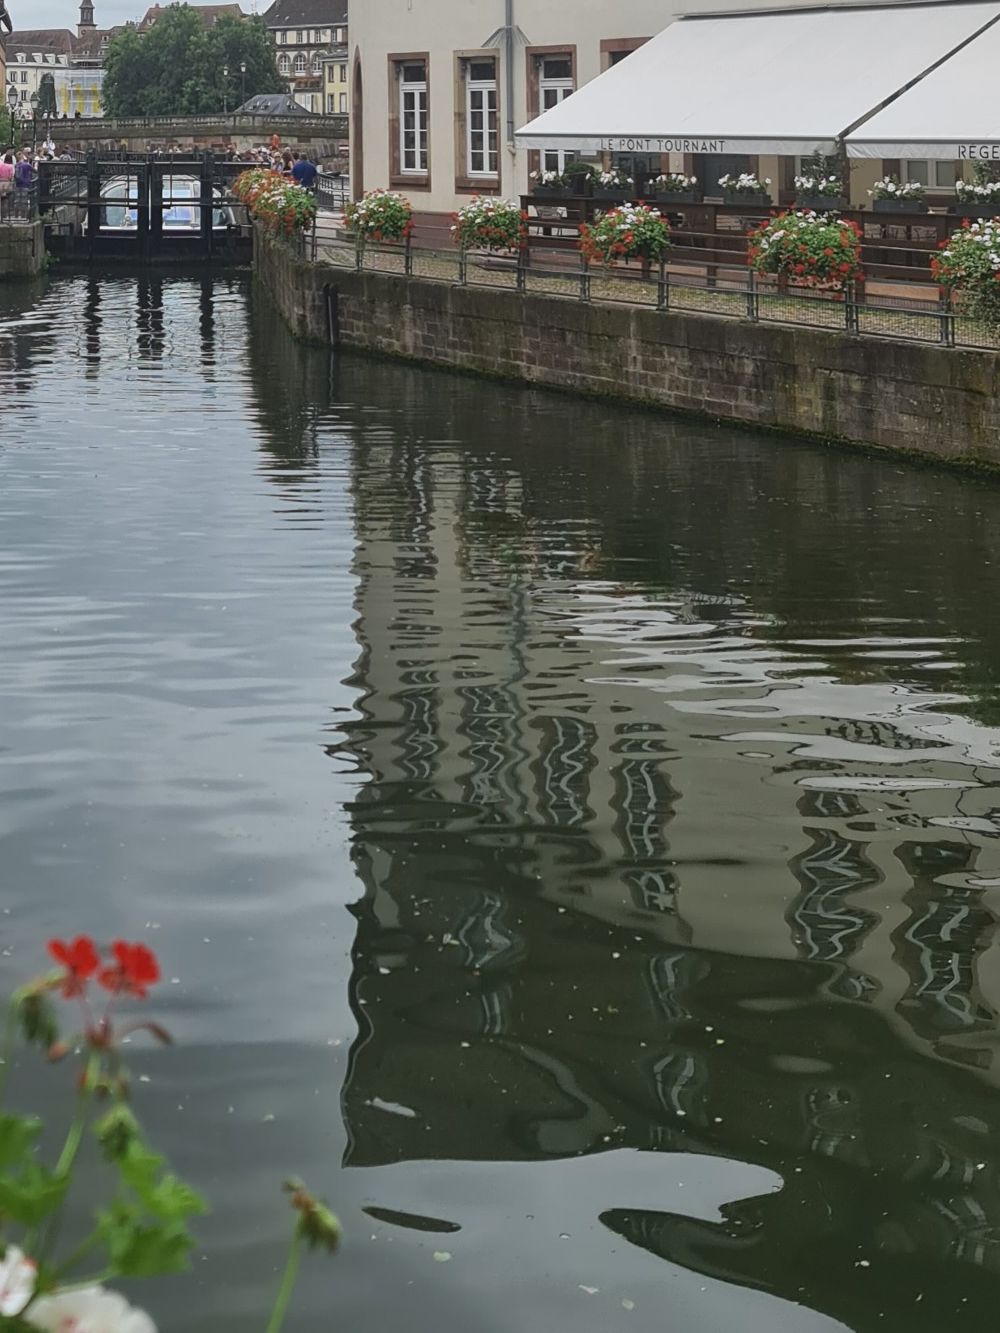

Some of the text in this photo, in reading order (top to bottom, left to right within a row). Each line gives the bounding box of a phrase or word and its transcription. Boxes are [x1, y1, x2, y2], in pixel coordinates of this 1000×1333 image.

[600, 138, 726, 153] LE PONT TOURNANT
